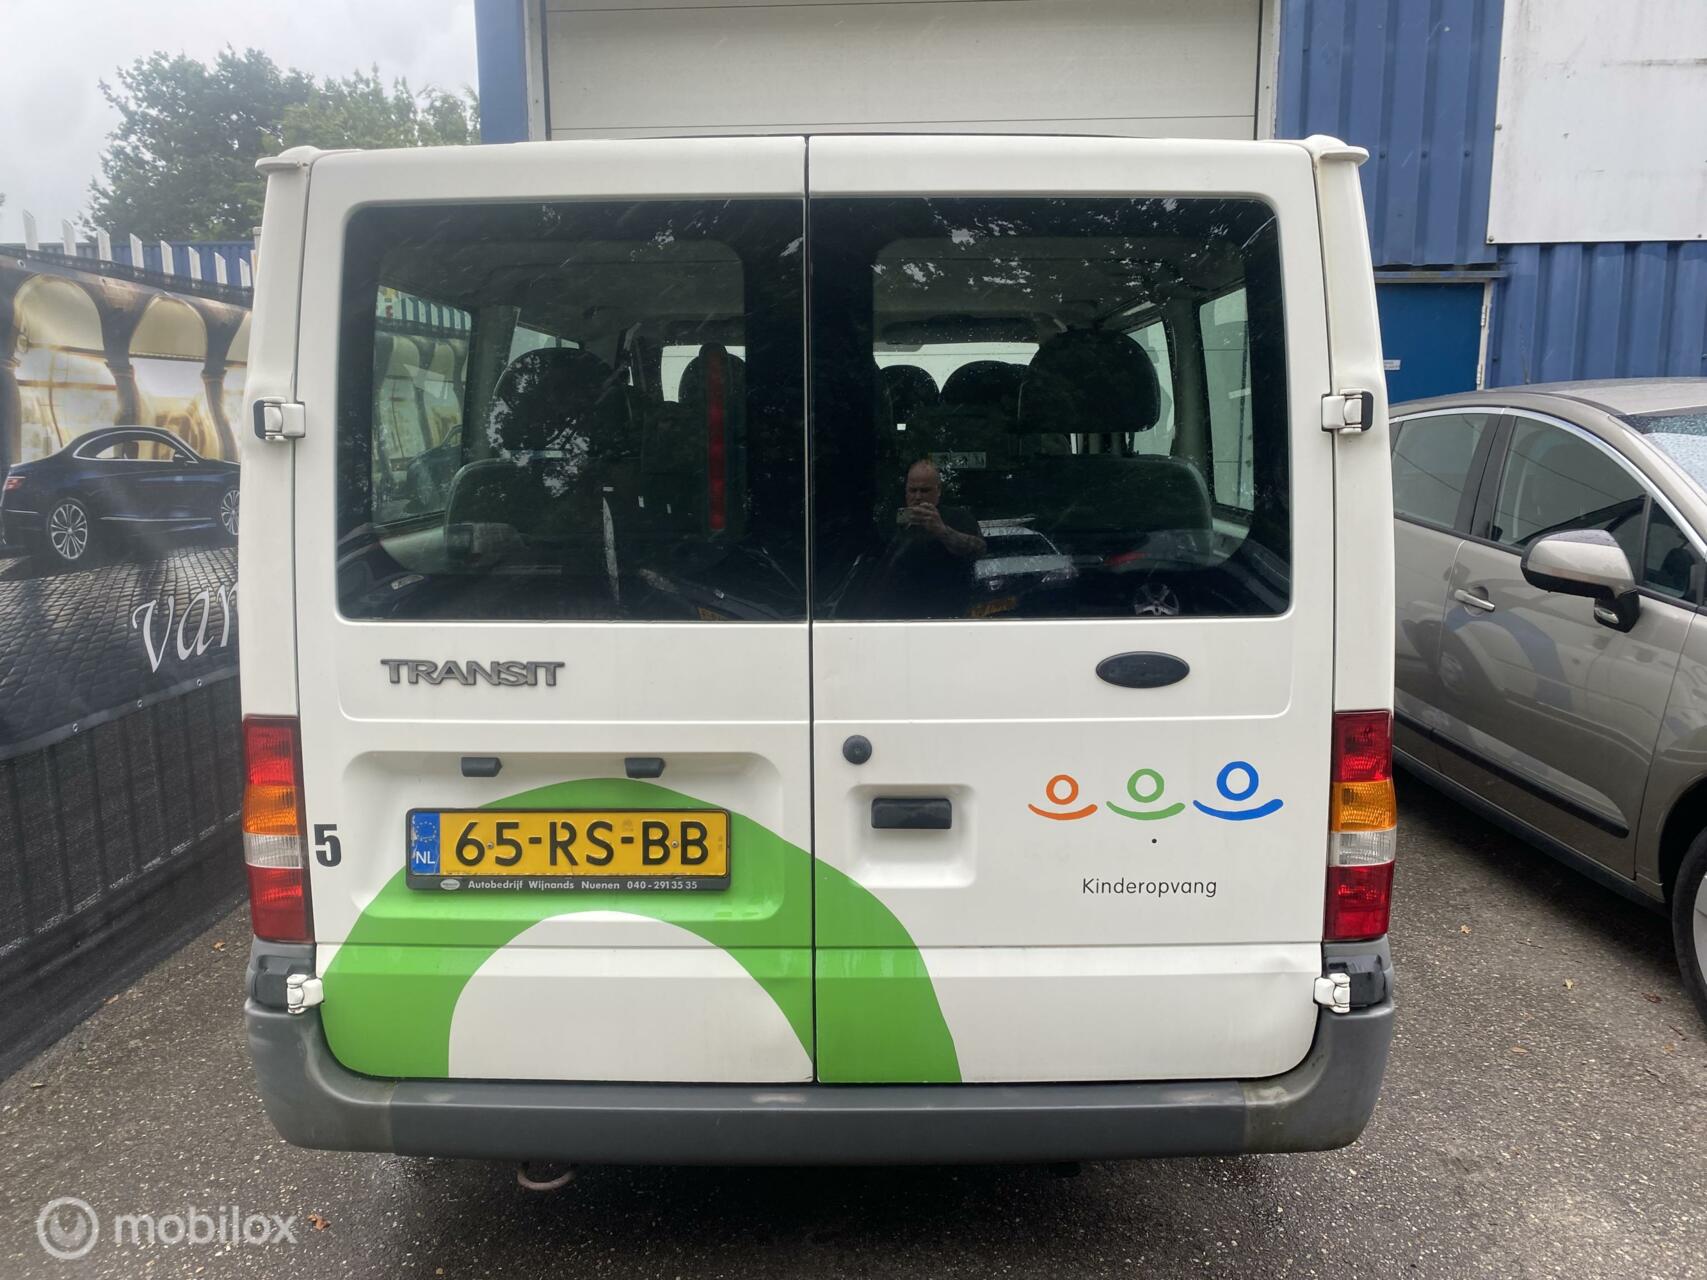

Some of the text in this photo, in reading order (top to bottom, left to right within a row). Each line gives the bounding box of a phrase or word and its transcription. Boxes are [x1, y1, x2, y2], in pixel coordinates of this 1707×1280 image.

[380, 659, 566, 687] TRANSIT
[313, 823, 342, 868] 5
[455, 820, 709, 867] 65-RS-BB
[416, 850, 436, 864] NL
[467, 879, 524, 891] Autobedrijf
[528, 879, 575, 891] Wijnands
[581, 880, 620, 890] Nuenen
[1082, 877, 1218, 899] Kinderopvang
